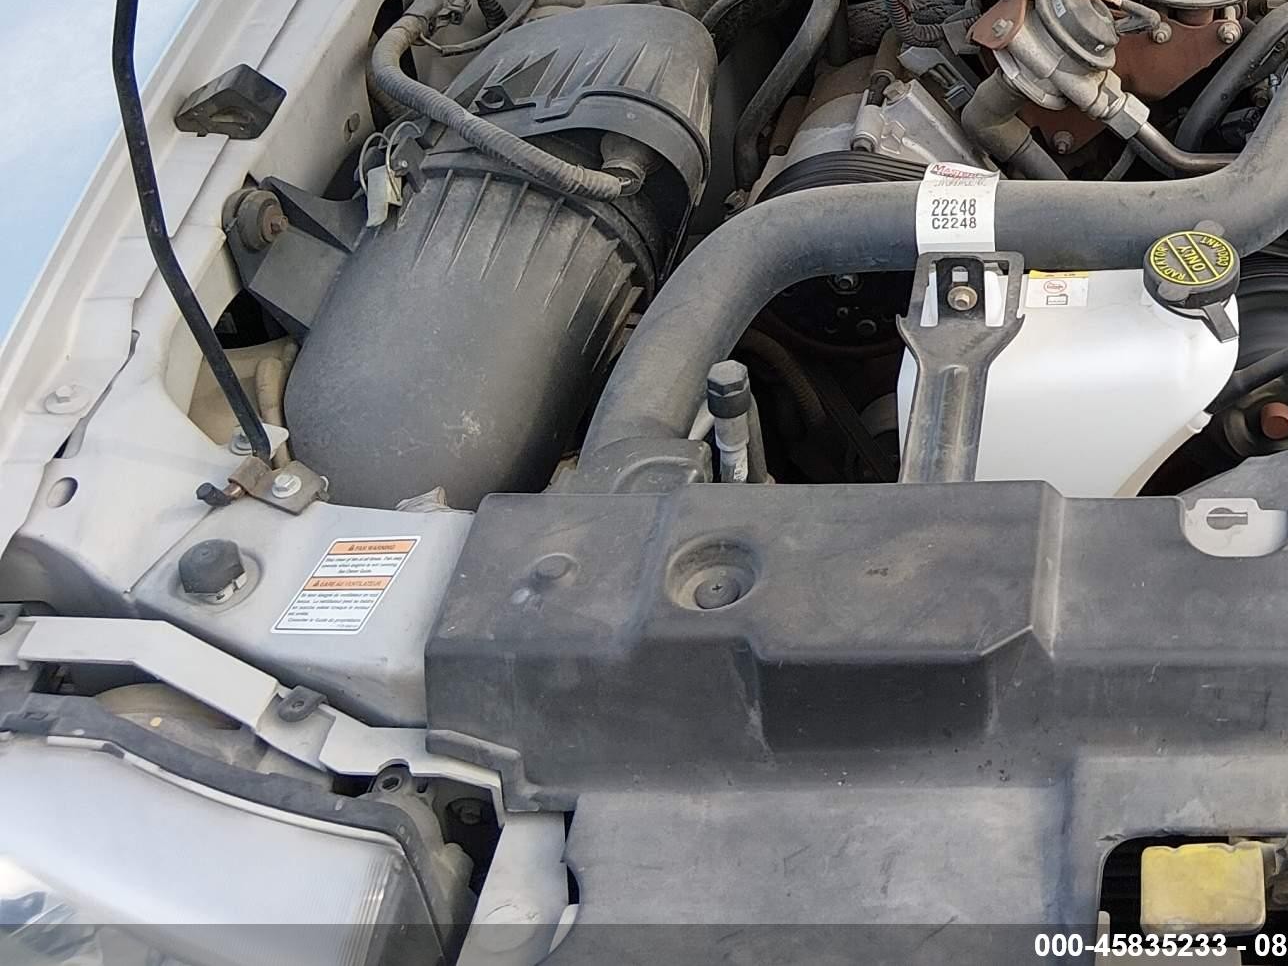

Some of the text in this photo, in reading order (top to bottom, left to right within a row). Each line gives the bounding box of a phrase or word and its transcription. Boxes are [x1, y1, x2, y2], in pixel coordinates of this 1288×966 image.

[931, 199, 977, 217] 22248
[931, 217, 977, 230] C2248
[1154, 243, 1186, 281] RADIATOR
[1176, 245, 1206, 272] ONLY
[1200, 236, 1230, 267] COOLANT
